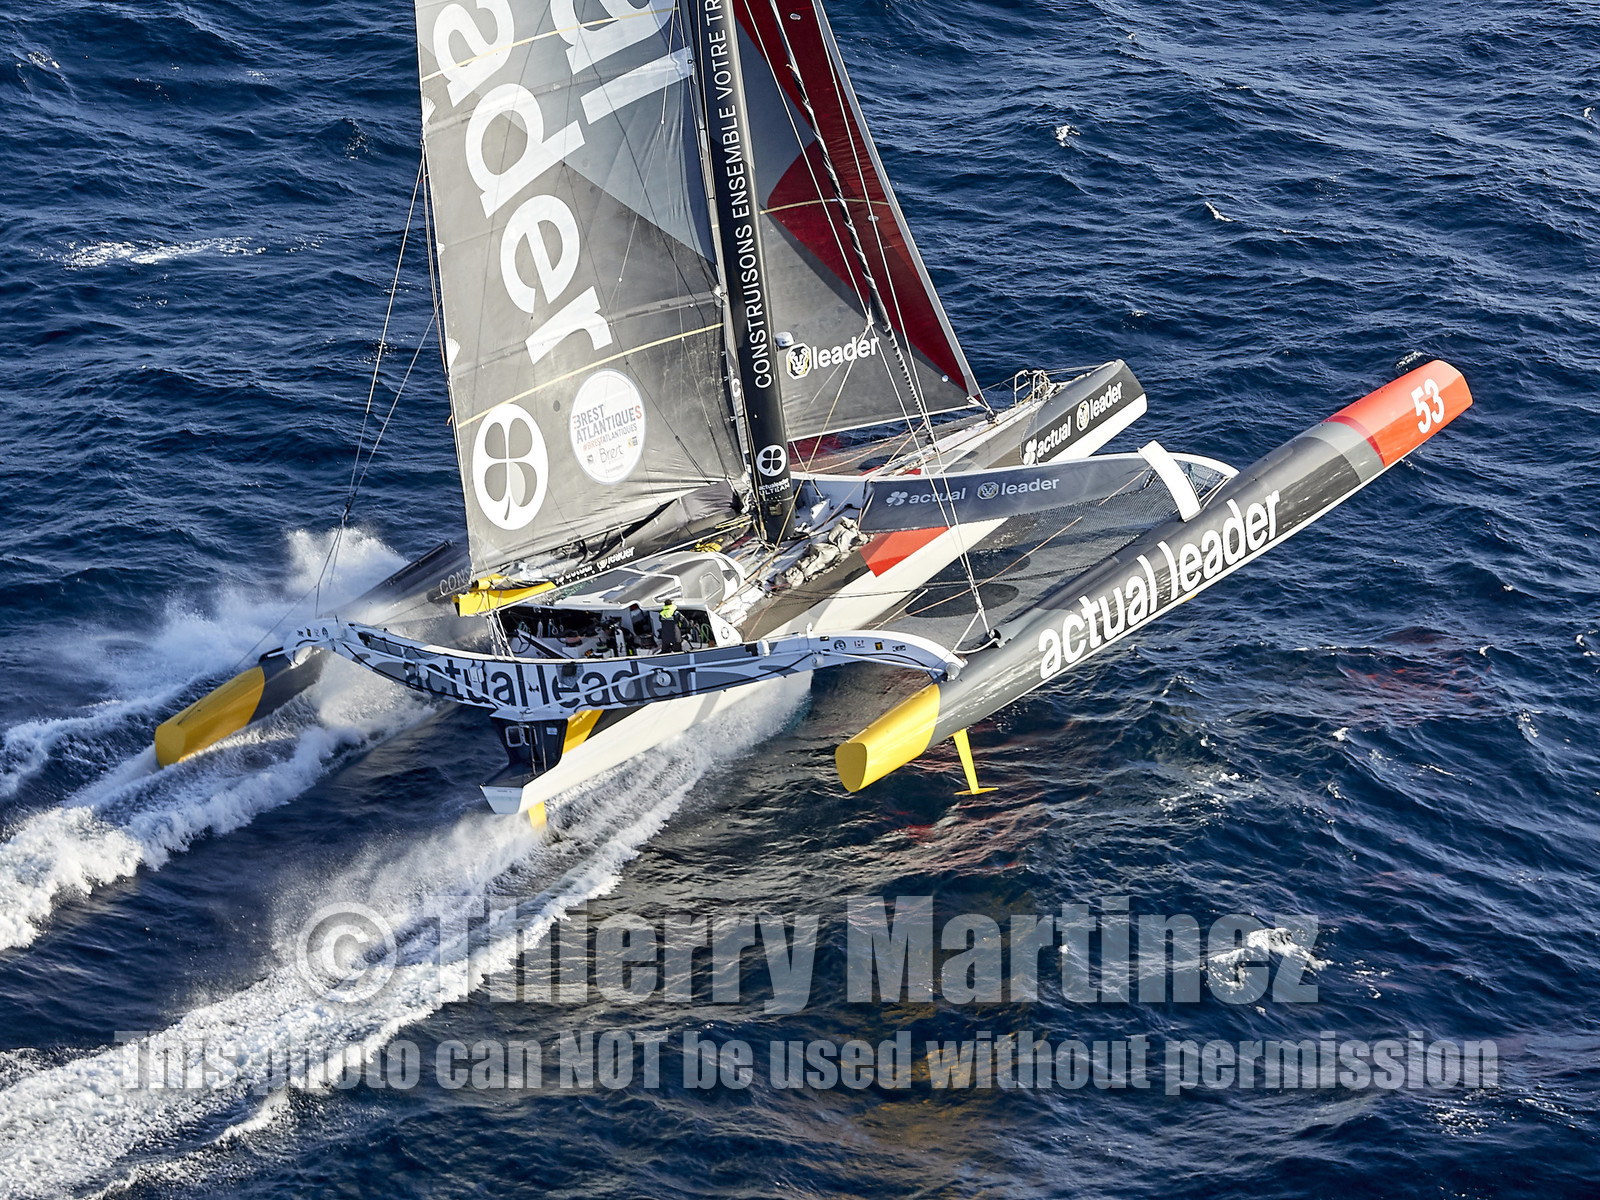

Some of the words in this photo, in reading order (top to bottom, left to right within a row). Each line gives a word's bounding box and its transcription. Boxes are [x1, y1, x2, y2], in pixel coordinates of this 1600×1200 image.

[709, 29, 737, 100] VOTRE
[719, 104, 750, 218] ENSEMBLE
[735, 224, 773, 389] CONSTRUISONS
[811, 336, 880, 371] leader
[572, 404, 604, 429] BREST
[576, 405, 642, 445] ATLANTIQUES
[1037, 415, 1073, 458] actual
[1090, 381, 1123, 421] leader
[1410, 378, 1446, 434] 53
[909, 487, 966, 504] actual
[1001, 478, 1060, 496] leader
[1038, 554, 1157, 680] actual
[1157, 490, 1281, 603] leader
[536, 660, 697, 709] leader
